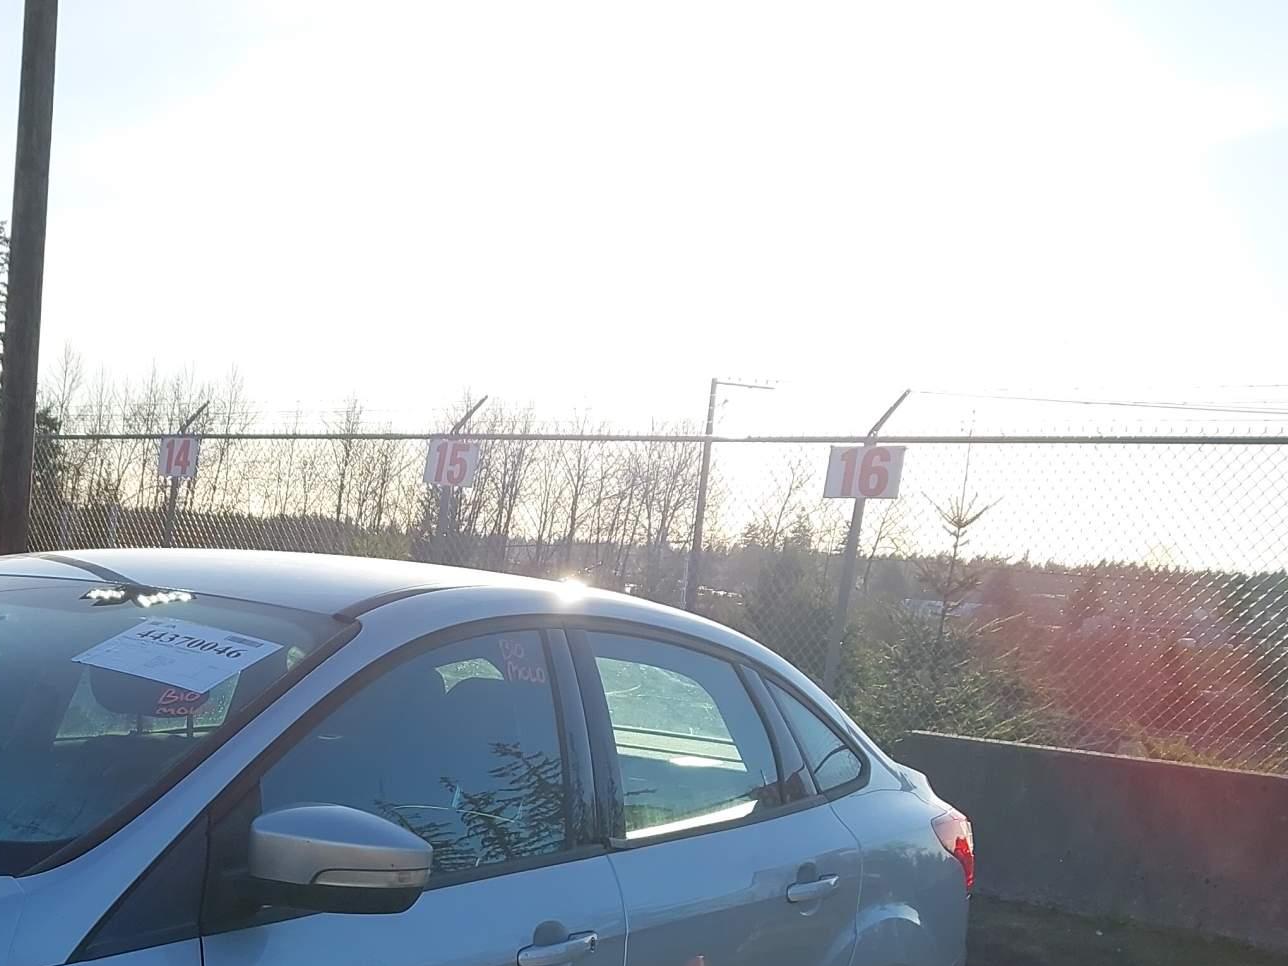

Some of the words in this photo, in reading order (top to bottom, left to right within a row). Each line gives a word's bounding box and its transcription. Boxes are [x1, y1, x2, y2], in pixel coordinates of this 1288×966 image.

[166, 439, 191, 474] 14
[434, 442, 470, 485] 15
[840, 447, 891, 497] 16
[136, 630, 249, 658] 44370046
[158, 688, 201, 705] BIO
